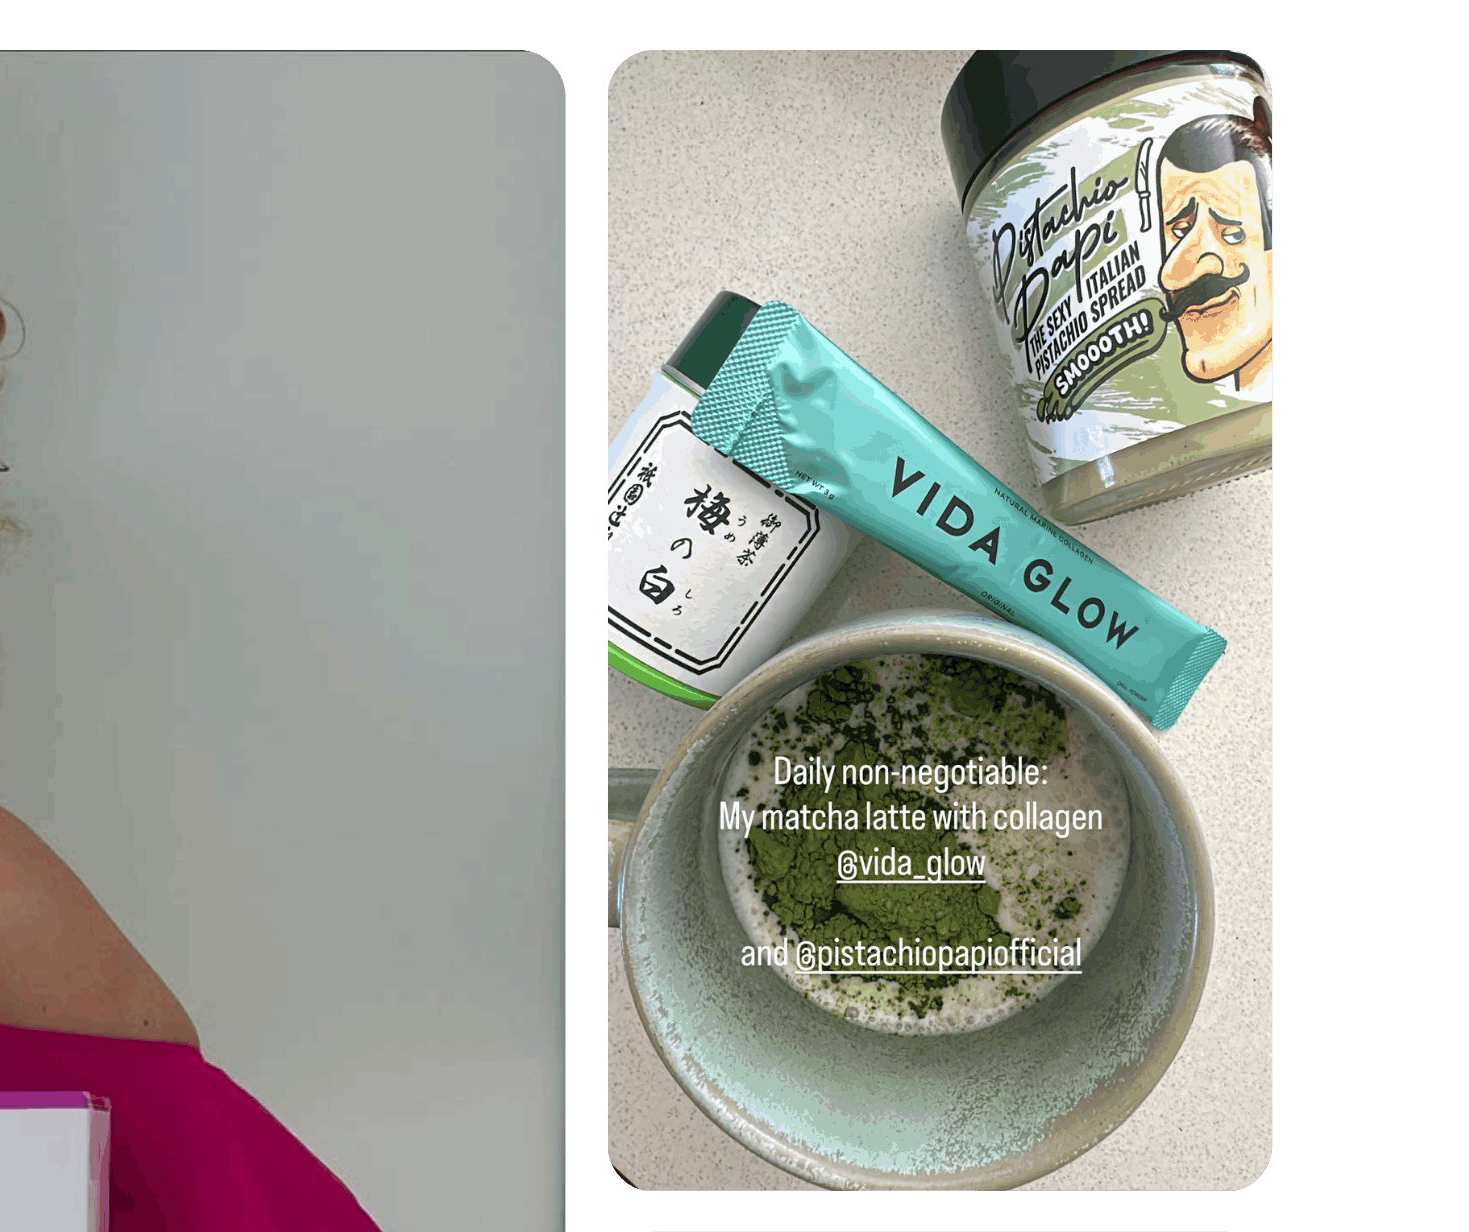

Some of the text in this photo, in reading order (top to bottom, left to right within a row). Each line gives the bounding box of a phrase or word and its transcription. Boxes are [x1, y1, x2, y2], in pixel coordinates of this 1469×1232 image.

[992, 166, 1129, 325] Pistachio
[1014, 210, 1120, 374] Papi
[1030, 240, 1141, 358] THE SEXY ITALIAN
[1035, 264, 1147, 381] PISTACHIO SPREAD
[1055, 310, 1151, 397] SMOOOTH!
[795, 470, 812, 484] NET
[811, 480, 826, 492] WT
[994, 486, 1094, 565] NATURAL MARINE COLLAGEN
[891, 455, 1140, 651] VIDA GLOW
[981, 590, 1016, 617] ORIGINAL
